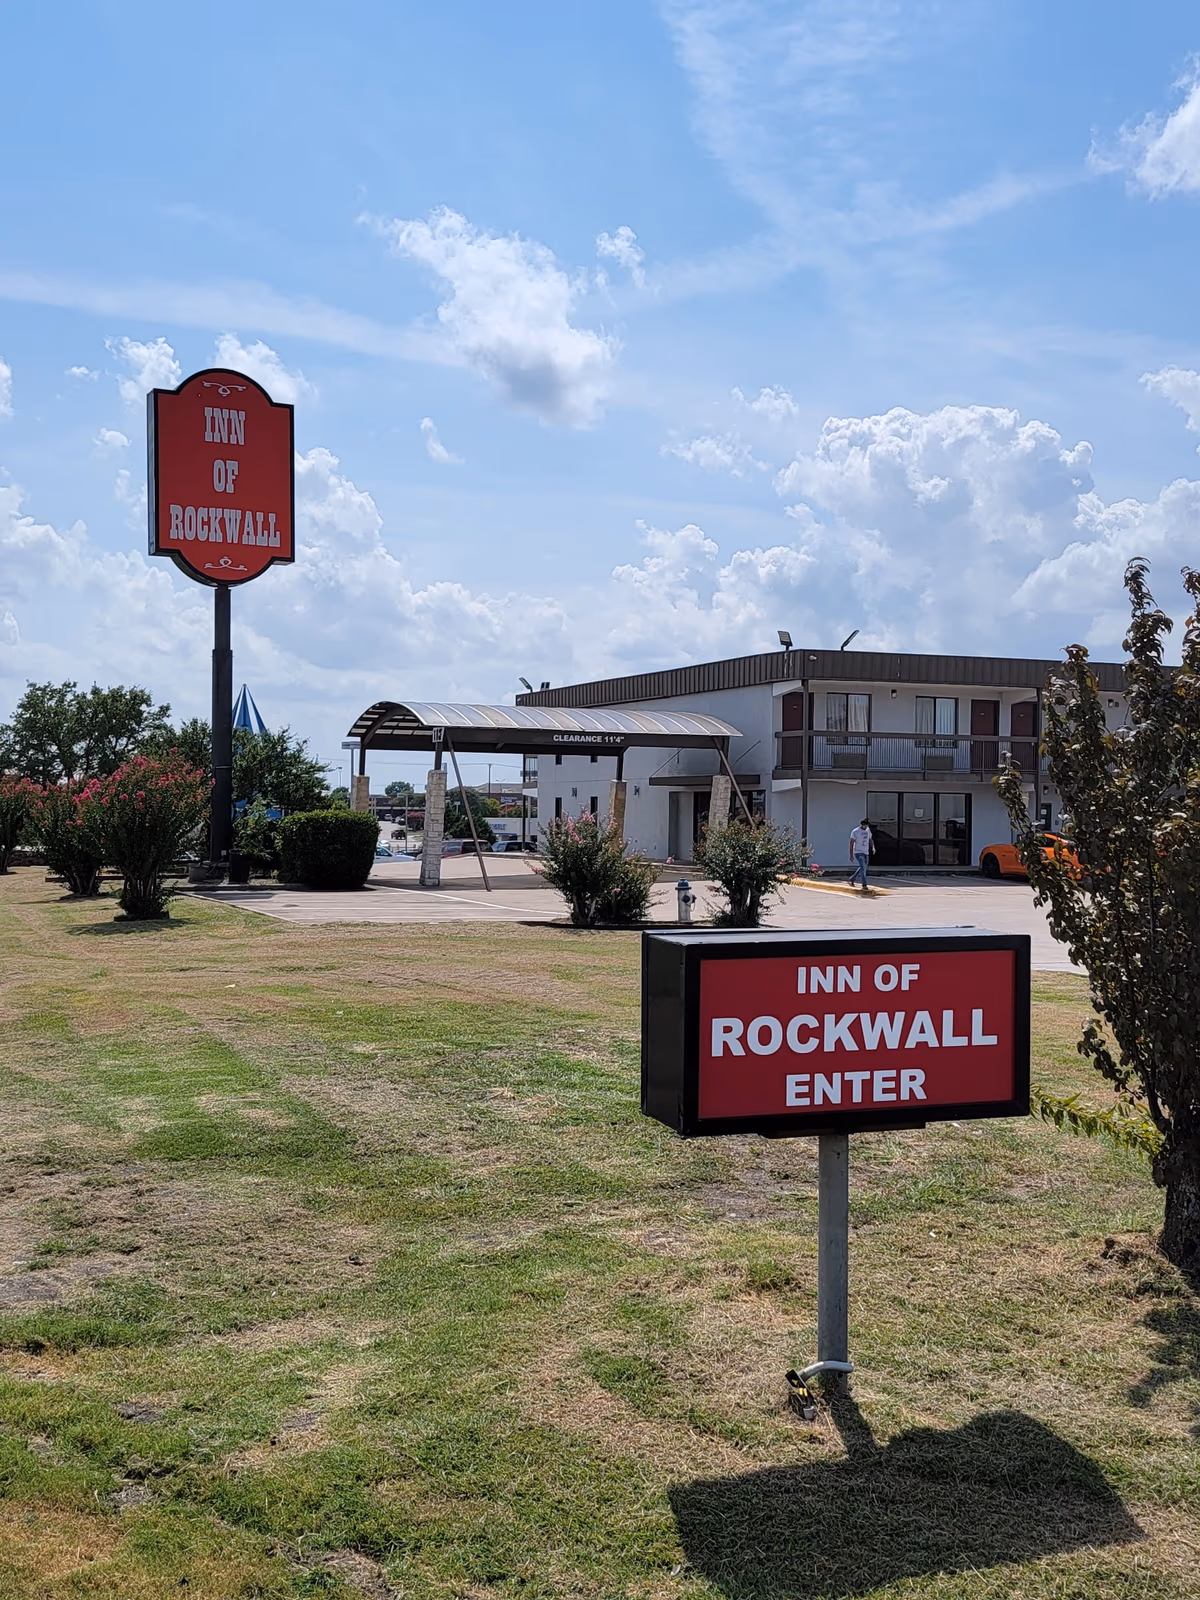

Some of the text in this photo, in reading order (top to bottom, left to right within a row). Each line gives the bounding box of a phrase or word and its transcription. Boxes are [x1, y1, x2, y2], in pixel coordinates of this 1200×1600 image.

[204, 407, 246, 446] INN
[213, 459, 239, 494] OF
[169, 504, 281, 548] ROCKWALL
[553, 734, 603, 743] CLEARANCE
[797, 963, 921, 995] INN OF
[710, 1008, 998, 1058] ROCKWALL
[785, 1068, 927, 1107] ENTER
